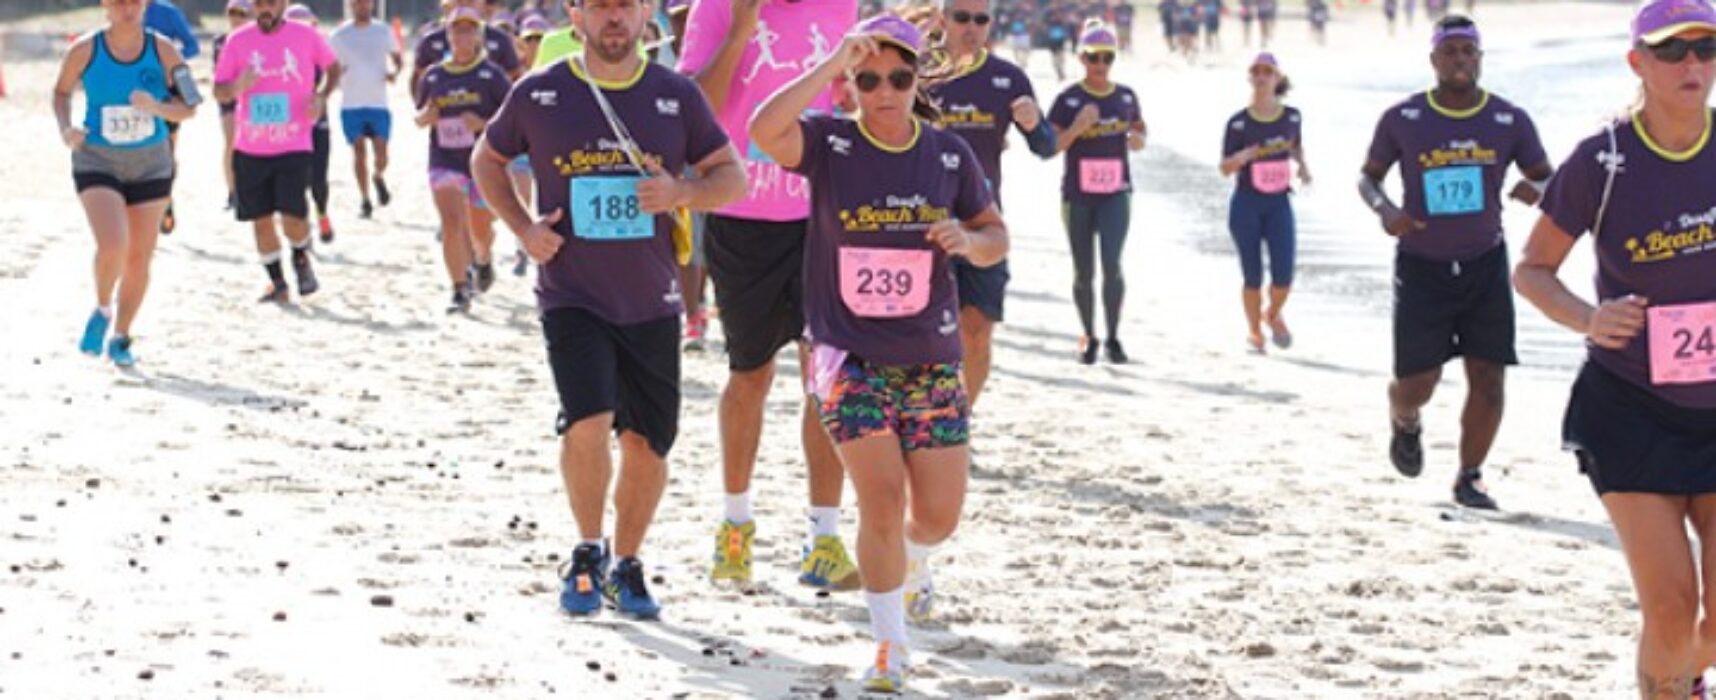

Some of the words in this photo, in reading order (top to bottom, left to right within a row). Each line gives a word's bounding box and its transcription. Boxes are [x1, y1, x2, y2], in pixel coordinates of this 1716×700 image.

[1439, 180, 1474, 199] 179
[588, 194, 640, 220] 188
[857, 205, 912, 223] Beach
[1645, 222, 1713, 251] Beach
[856, 267, 913, 296] 239
